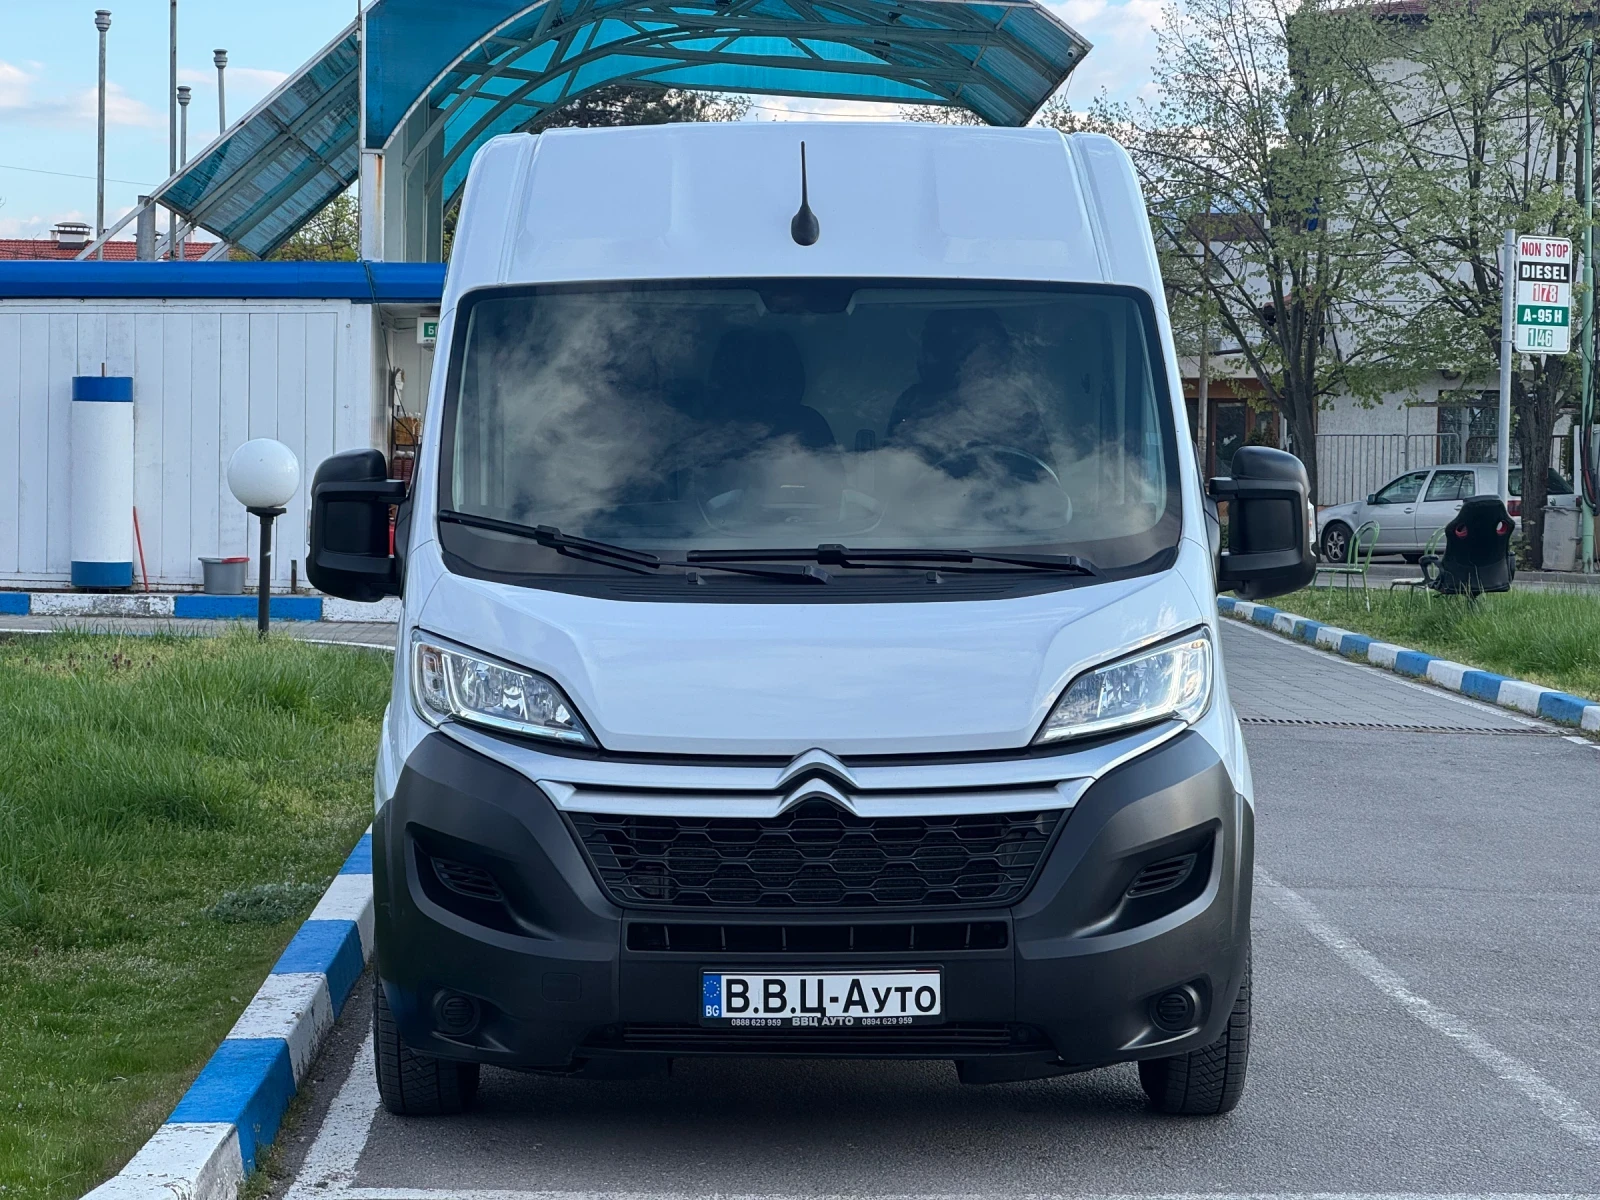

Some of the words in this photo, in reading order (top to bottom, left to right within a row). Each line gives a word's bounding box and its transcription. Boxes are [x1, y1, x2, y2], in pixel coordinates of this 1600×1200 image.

[1521, 241, 1542, 256] NON
[1545, 243, 1569, 258] STOP
[1522, 264, 1567, 280] DIESEL
[1533, 283, 1558, 303] 178
[1528, 328, 1553, 347] 146
[705, 1005, 720, 1017] BG
[731, 1018, 750, 1026] 0888
[751, 1018, 766, 1026] 629
[767, 1018, 782, 1026] 959
[792, 1016, 819, 1027] ВВЦ
[821, 1016, 854, 1026] АУТО
[861, 1017, 881, 1026] 0894
[882, 1017, 897, 1025] 629
[898, 1016, 913, 1025] 959
